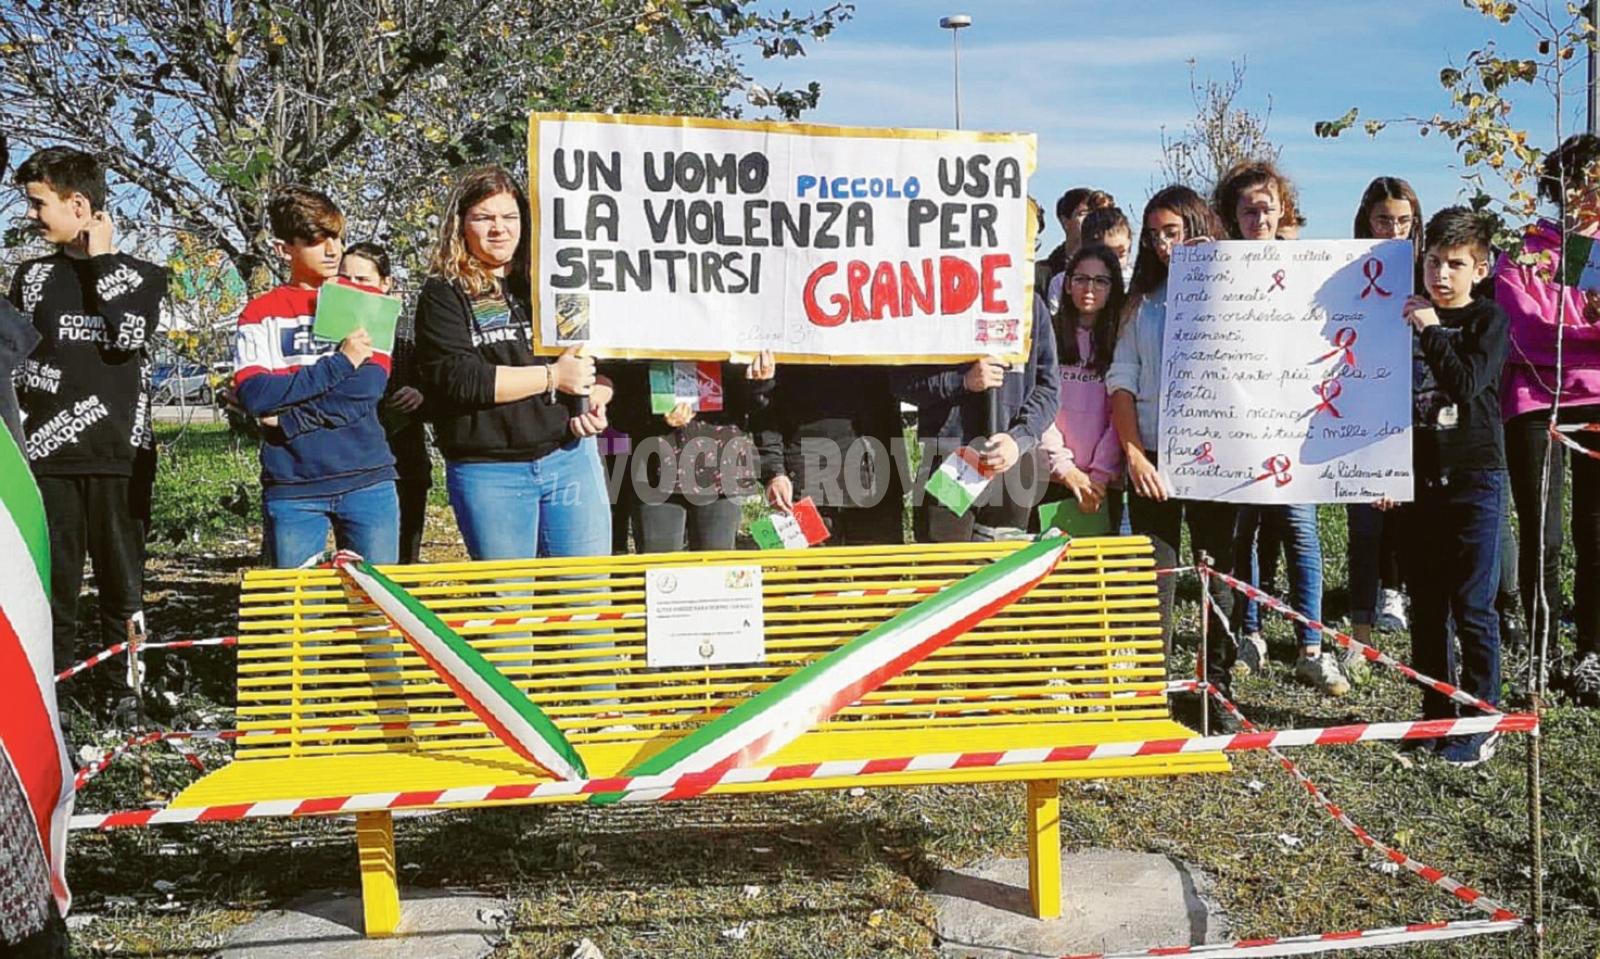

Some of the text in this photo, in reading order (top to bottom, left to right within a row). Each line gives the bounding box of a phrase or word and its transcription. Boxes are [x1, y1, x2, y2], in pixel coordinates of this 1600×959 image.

[553, 149, 1021, 199] UN UOMO PICCOLO USA
[553, 198, 998, 248] LA VIOLENZA PER
[551, 248, 1012, 327] SENTIRSI GRANDE
[74, 395, 99, 415] des
[1167, 403, 1238, 419] stammi
